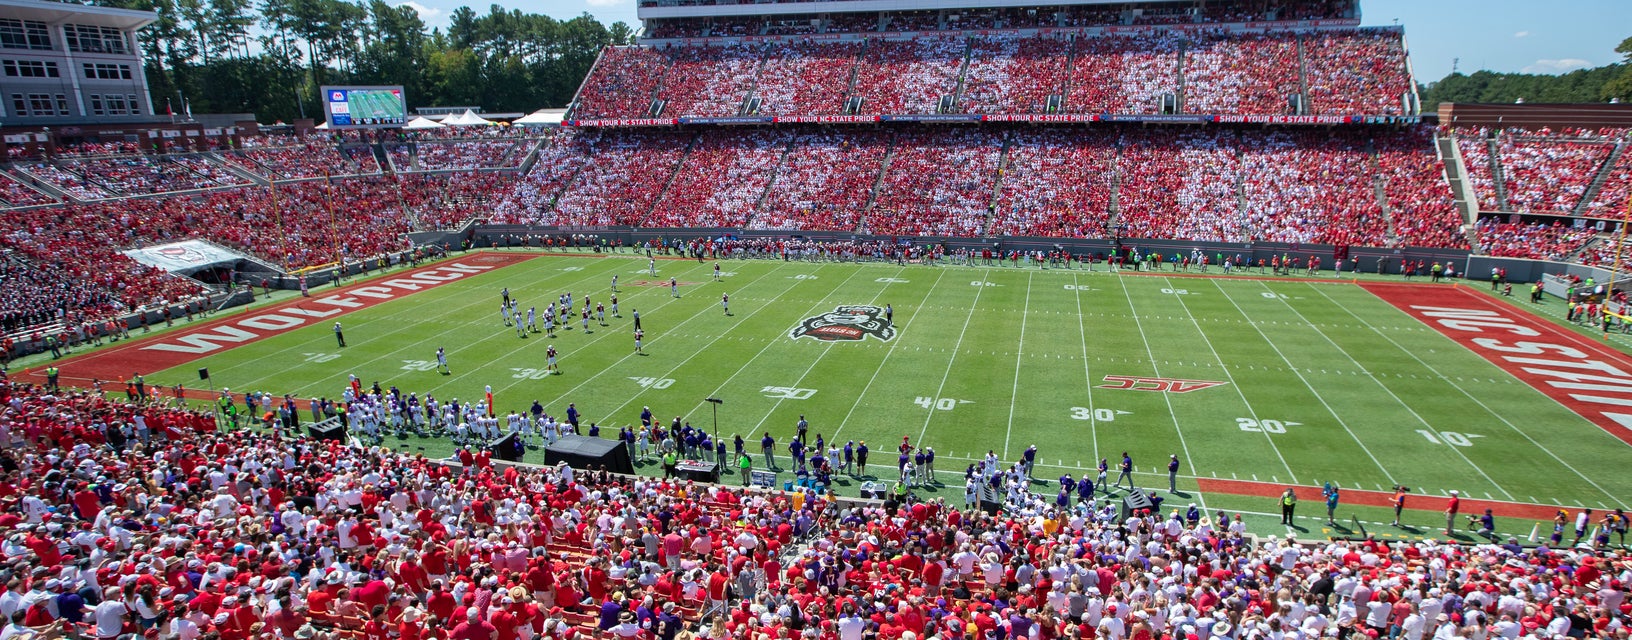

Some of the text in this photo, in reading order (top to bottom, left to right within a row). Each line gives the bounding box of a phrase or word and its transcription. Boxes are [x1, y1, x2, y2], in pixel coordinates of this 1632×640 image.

[138, 263, 495, 354] WOLFPACK
[1409, 305, 1541, 336] NC
[512, 368, 553, 380] 30
[637, 377, 676, 390] 40
[1093, 374, 1230, 393] ACC
[914, 396, 956, 411] 40
[1070, 407, 1114, 422] 30
[1236, 417, 1287, 434] 20
[1415, 429, 1473, 447] 10
